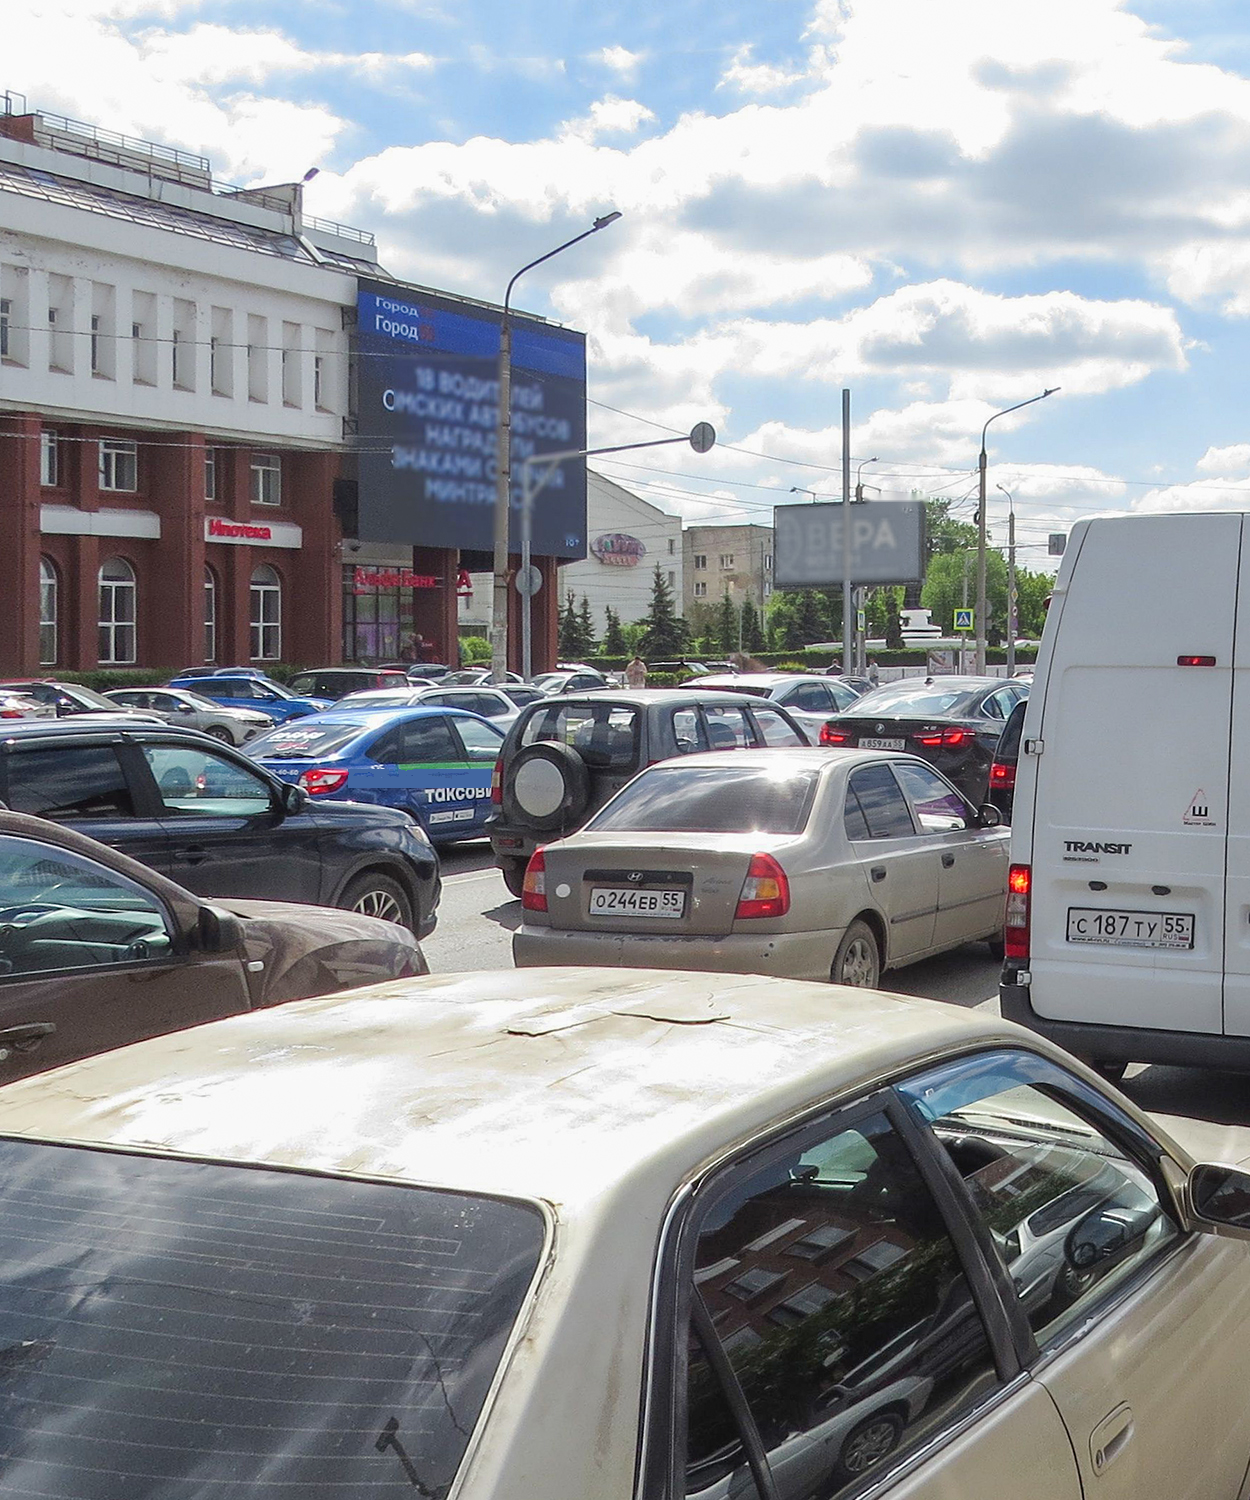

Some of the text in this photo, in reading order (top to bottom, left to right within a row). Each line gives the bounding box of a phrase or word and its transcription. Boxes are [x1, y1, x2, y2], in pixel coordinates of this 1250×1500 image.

[375, 296, 420, 318] Город
[375, 314, 420, 341] Город
[209, 519, 272, 540] Ипотека
[1192, 805, 1208, 816] Ш
[1063, 841, 1132, 855] TRANSIT
[662, 893, 679, 906] 55
[1164, 917, 1184, 934] 55
